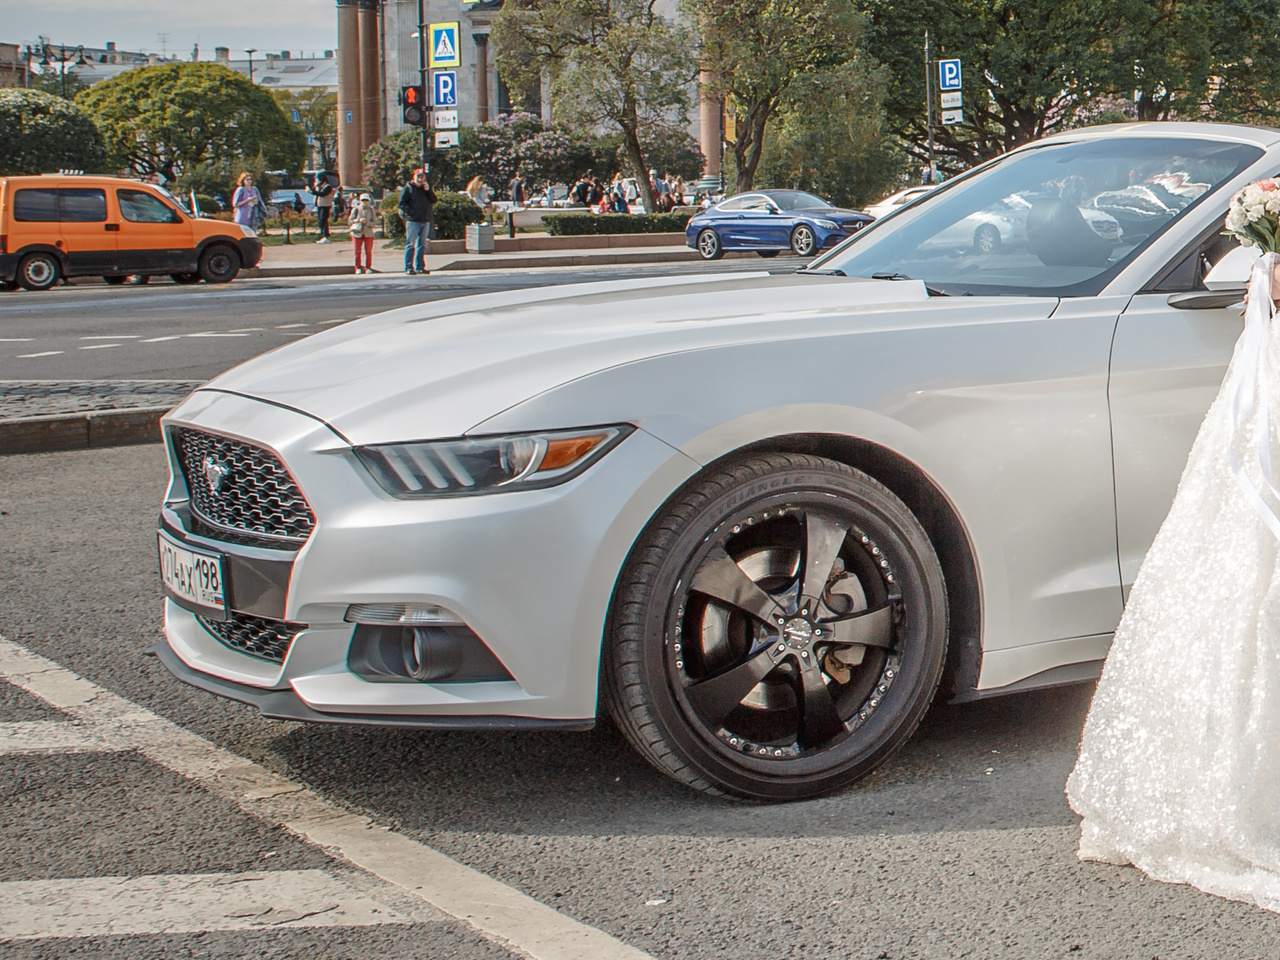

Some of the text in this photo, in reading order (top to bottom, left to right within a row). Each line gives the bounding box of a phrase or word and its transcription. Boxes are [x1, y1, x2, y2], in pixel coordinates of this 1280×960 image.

[945, 63, 957, 86] P
[439, 76, 452, 103] P
[196, 558, 219, 592] 198
